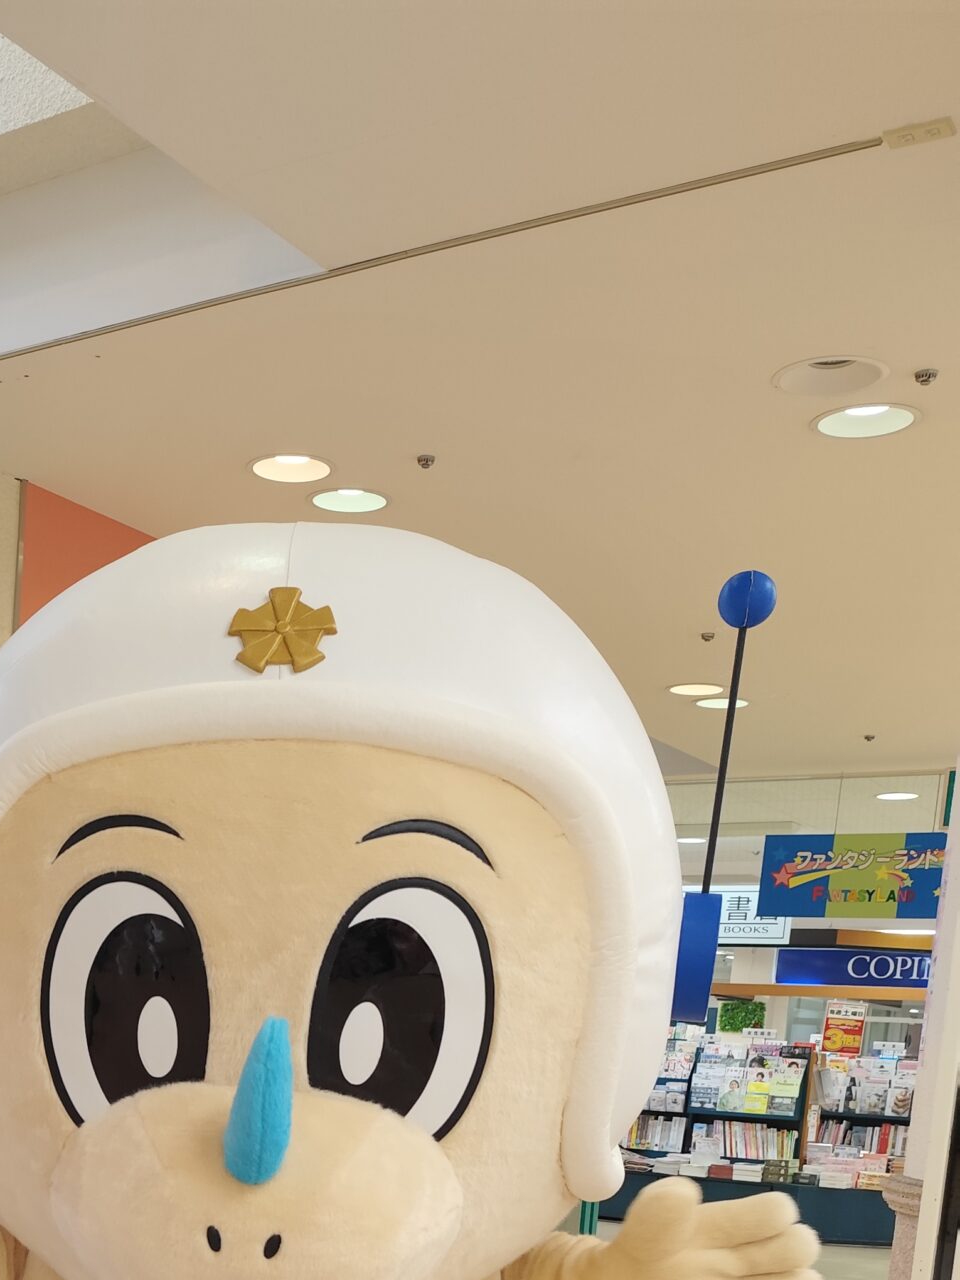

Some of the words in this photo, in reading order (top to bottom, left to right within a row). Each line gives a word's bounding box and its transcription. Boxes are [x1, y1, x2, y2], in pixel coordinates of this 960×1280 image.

[797, 848, 939, 870] ファンタジーランド
[726, 895, 778, 921] 書
[723, 925, 769, 935] BOOKS
